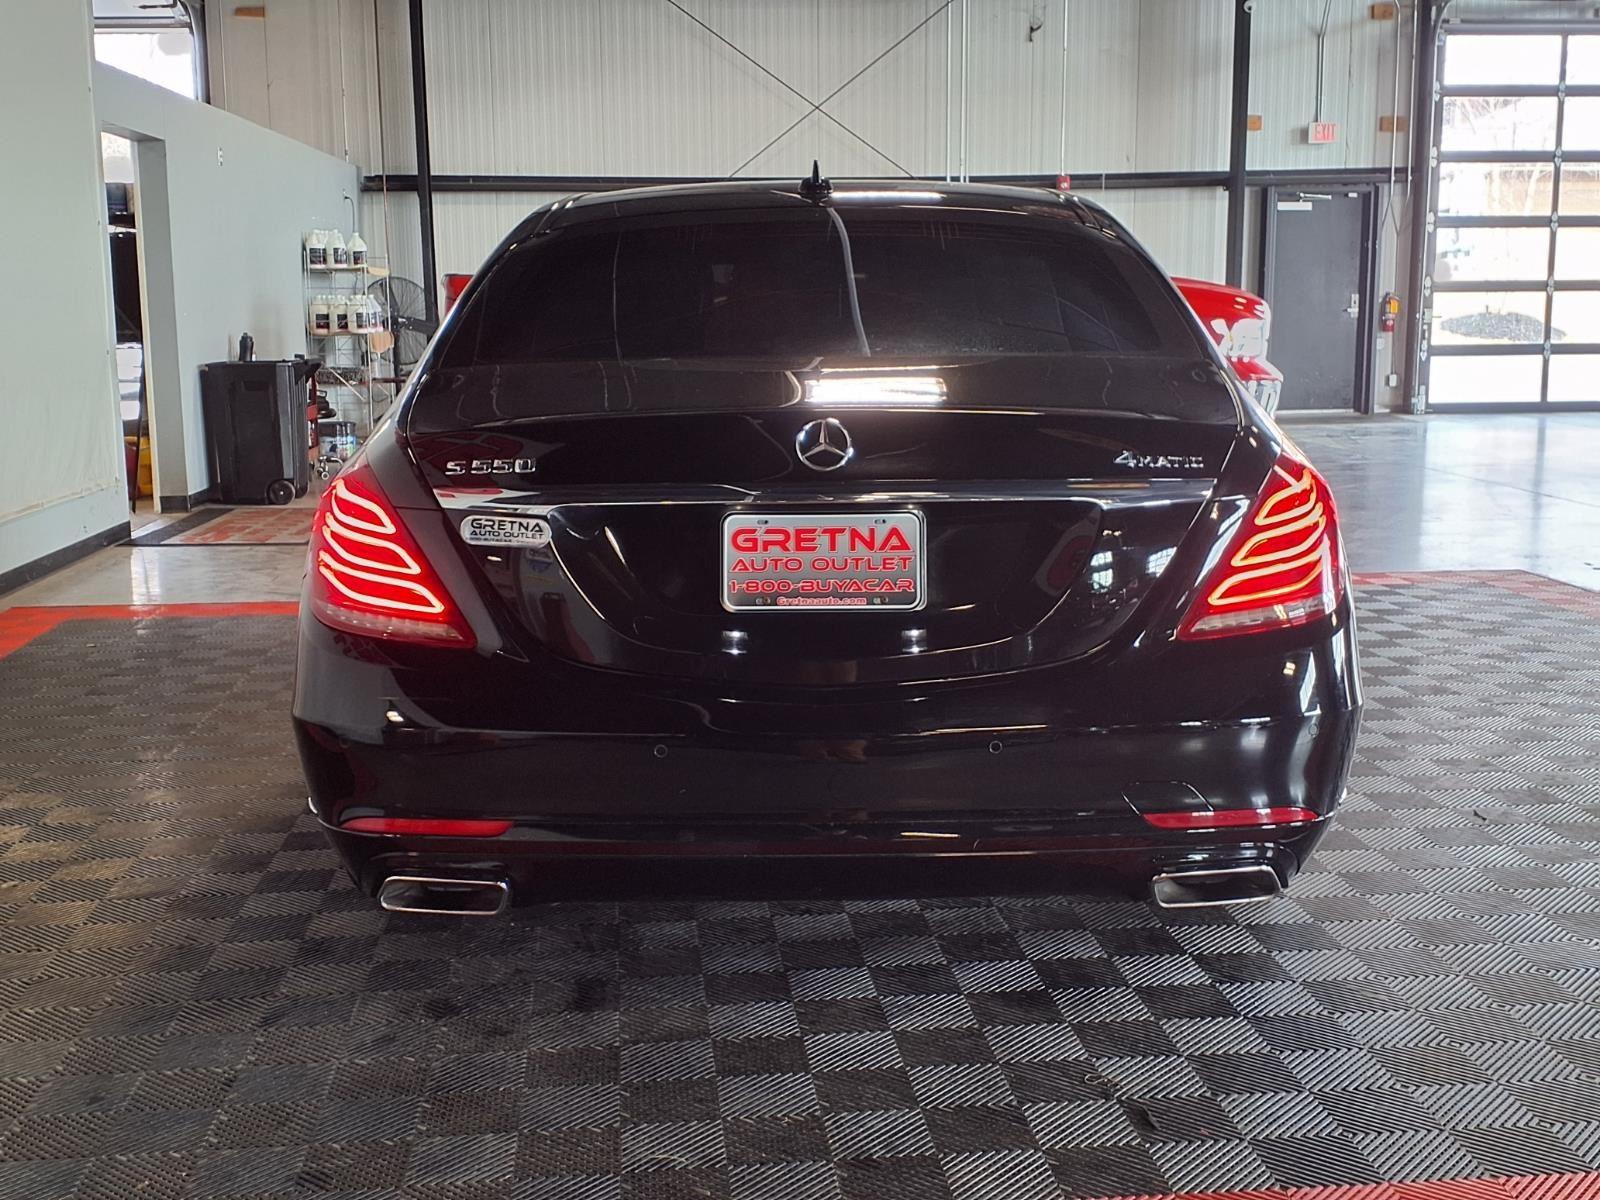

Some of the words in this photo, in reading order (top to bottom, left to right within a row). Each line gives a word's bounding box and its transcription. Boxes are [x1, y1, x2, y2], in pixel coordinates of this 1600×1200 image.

[1314, 123, 1337, 140] EXIT
[445, 461, 466, 475] S
[470, 459, 536, 474] 550
[1113, 450, 1204, 468] 4MATIC
[470, 518, 544, 533] GRETNA
[503, 531, 545, 539] OUTLET
[731, 526, 912, 553] GRETNA
[730, 557, 804, 573] AUTO
[811, 556, 915, 572] OUTLET
[729, 578, 915, 593] 1-800-BUYACAR
[776, 596, 868, 606] Gretnaauto.com
